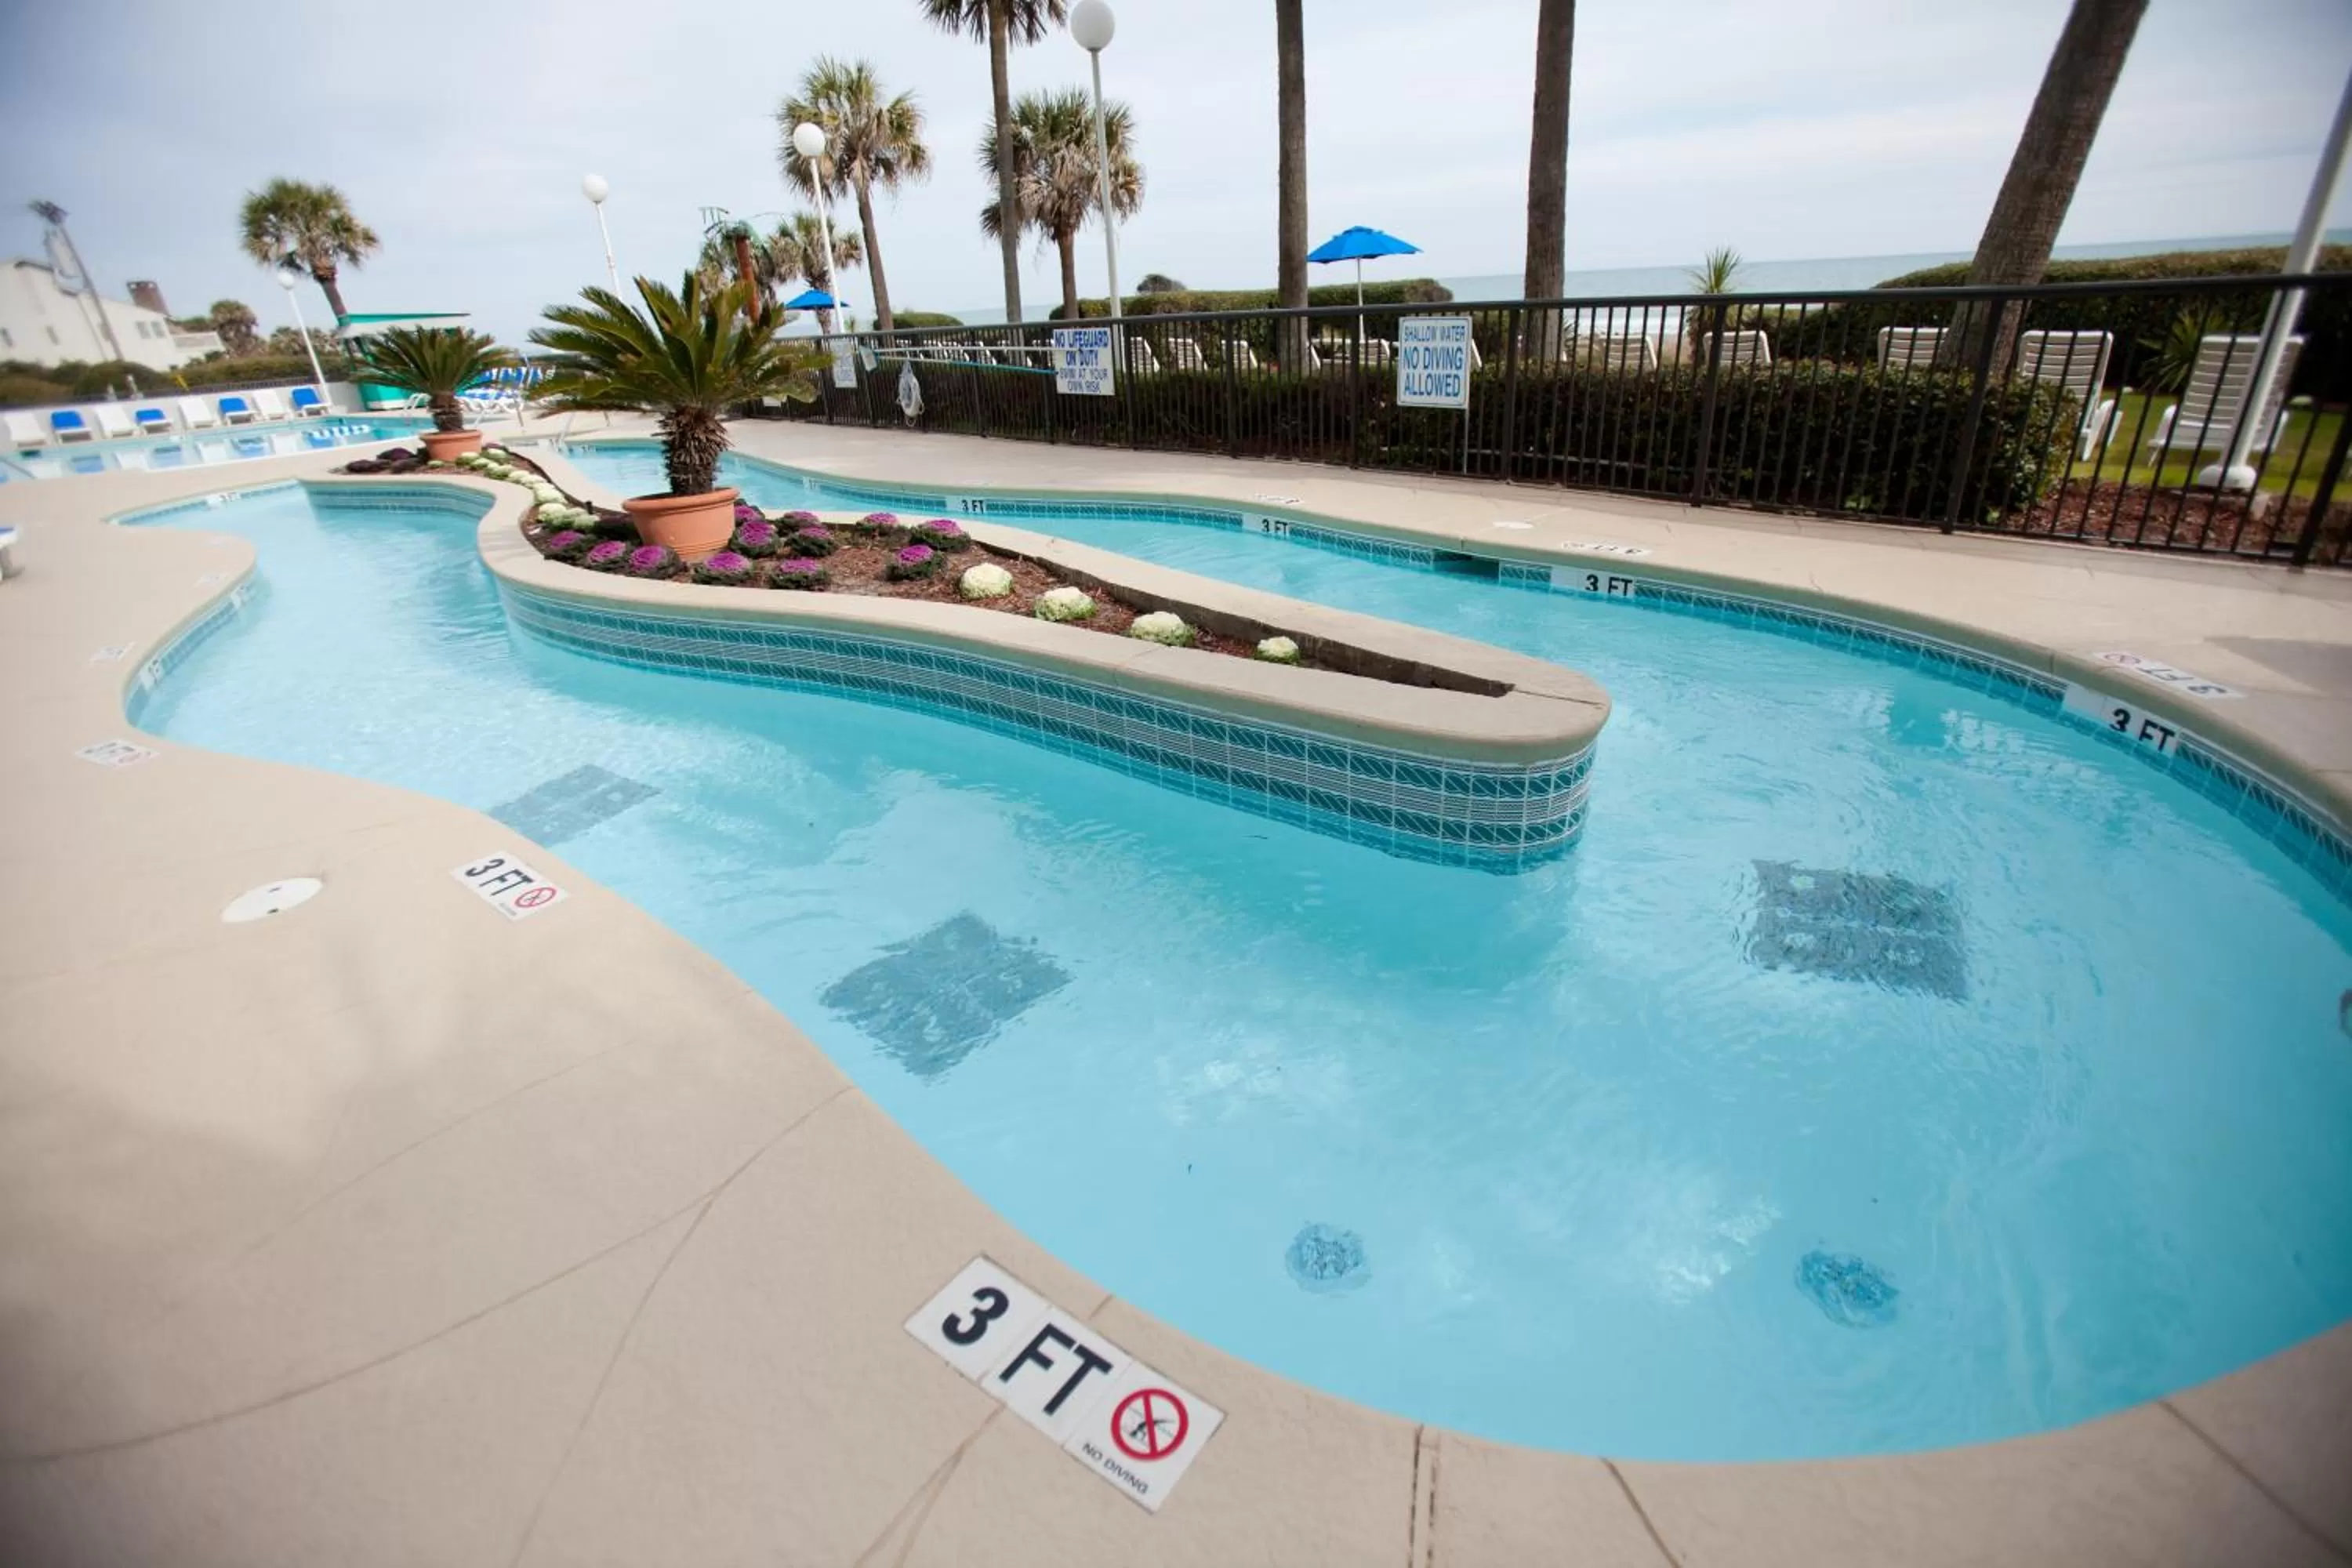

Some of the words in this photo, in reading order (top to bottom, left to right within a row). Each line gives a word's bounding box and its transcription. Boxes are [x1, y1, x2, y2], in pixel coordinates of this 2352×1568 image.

[1054, 330, 1065, 347] NO
[1067, 330, 1109, 347] LIFEGUARD
[1404, 325, 1437, 342] SHALLOW
[1440, 325, 1465, 342] WATER
[1066, 350, 1076, 366] ON
[1079, 350, 1098, 367] DUTY
[1403, 347, 1419, 369] NO
[1423, 347, 1463, 371] DIVING
[1404, 373, 1461, 397] ALLOWED
[961, 499, 969, 514] 3
[971, 499, 984, 514] FT
[1261, 518, 1270, 534] 3
[1274, 521, 1288, 537] FT
[1584, 574, 1599, 592] 3
[1607, 576, 1633, 597] FT
[2110, 708, 2132, 733] 3
[2138, 718, 2176, 753] FT
[465, 858, 506, 877] 3
[478, 868, 535, 896] FT
[942, 1287, 1010, 1346] 3
[998, 1322, 1114, 1417] FT
[1082, 1442, 1103, 1461] NO
[1103, 1458, 1149, 1495] DIVING
